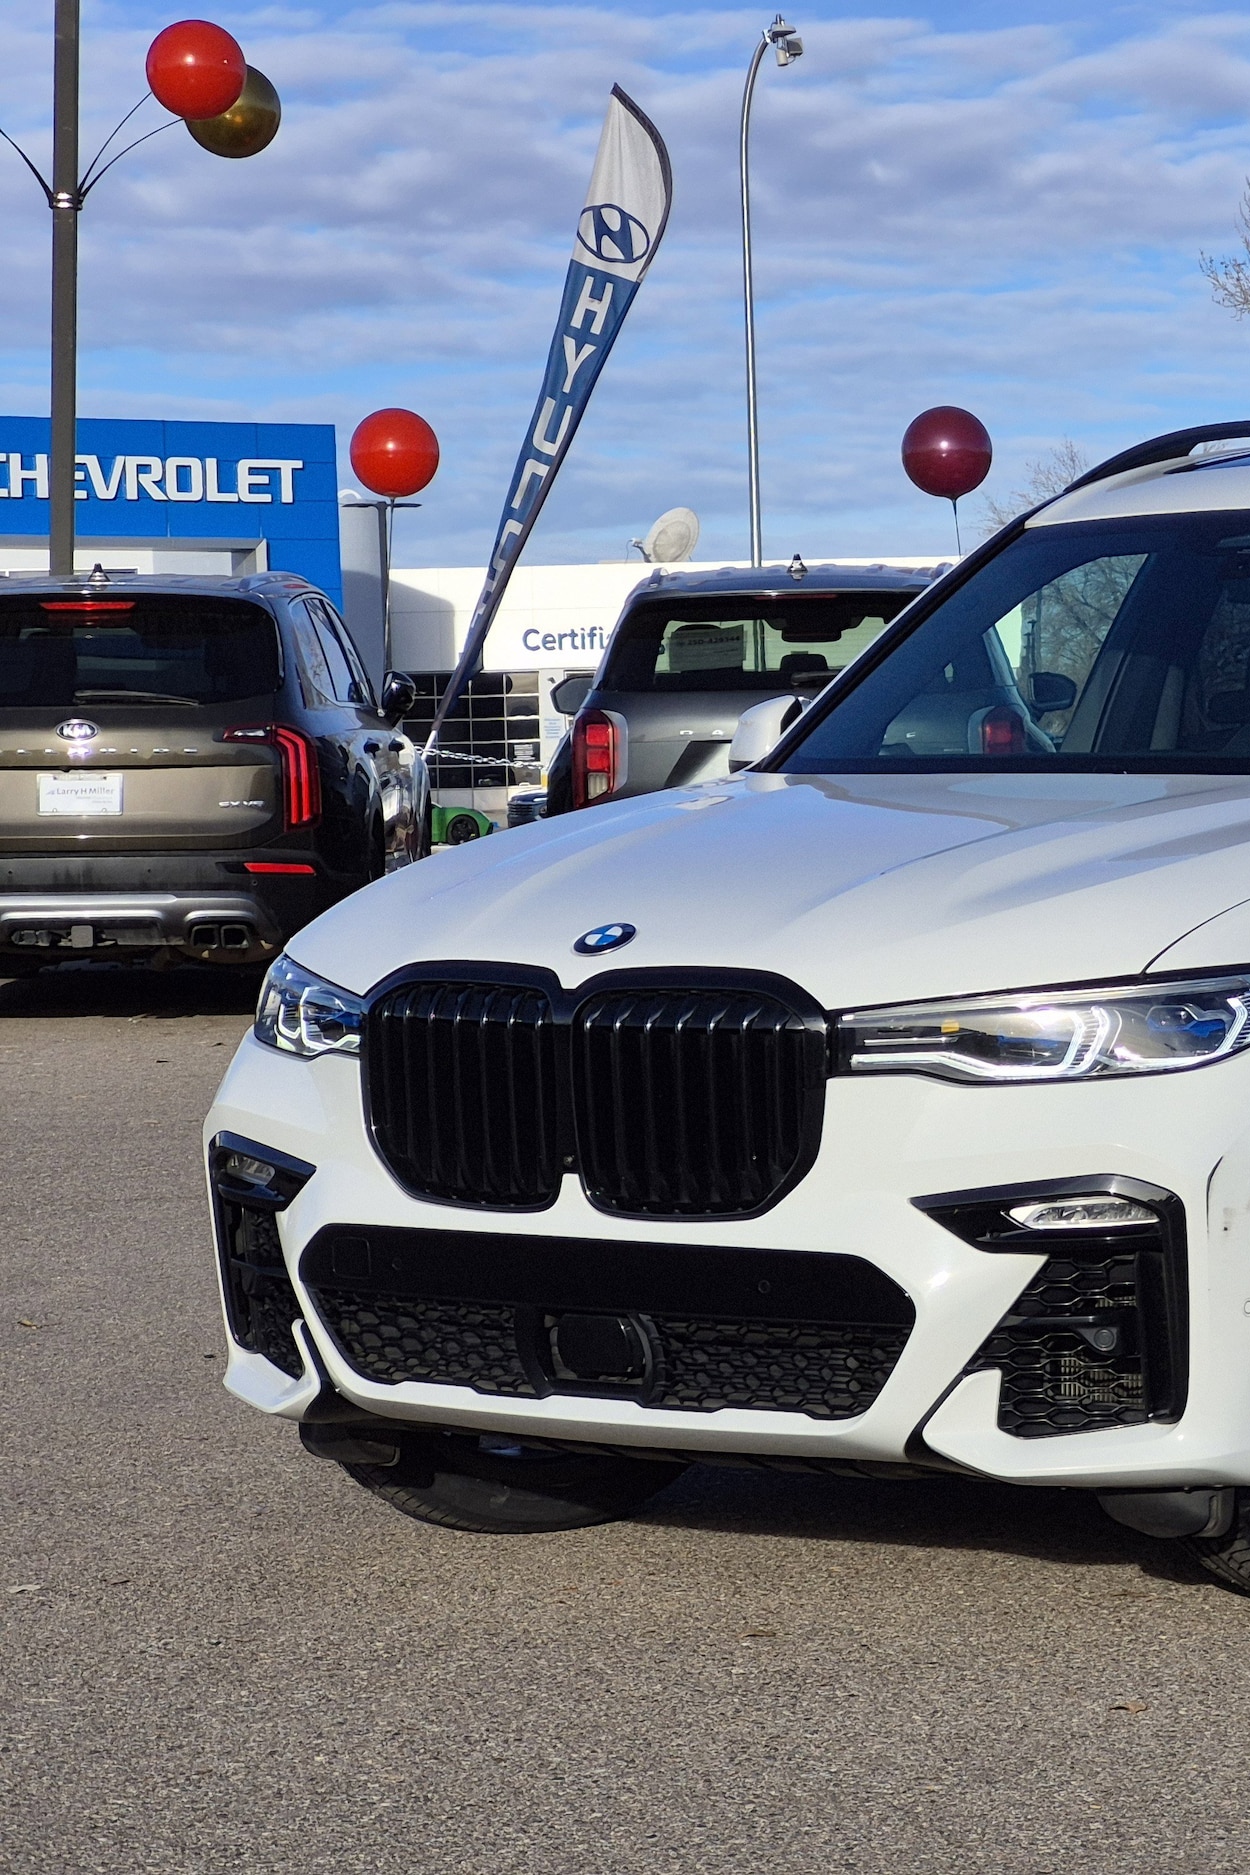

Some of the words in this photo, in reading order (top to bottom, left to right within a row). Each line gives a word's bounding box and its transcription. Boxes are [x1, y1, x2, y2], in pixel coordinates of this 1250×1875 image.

[0, 453, 303, 503] HVROLET
[522, 626, 611, 651] Certifi
[56, 788, 79, 796] Larry
[89, 787, 114, 795] Miller
